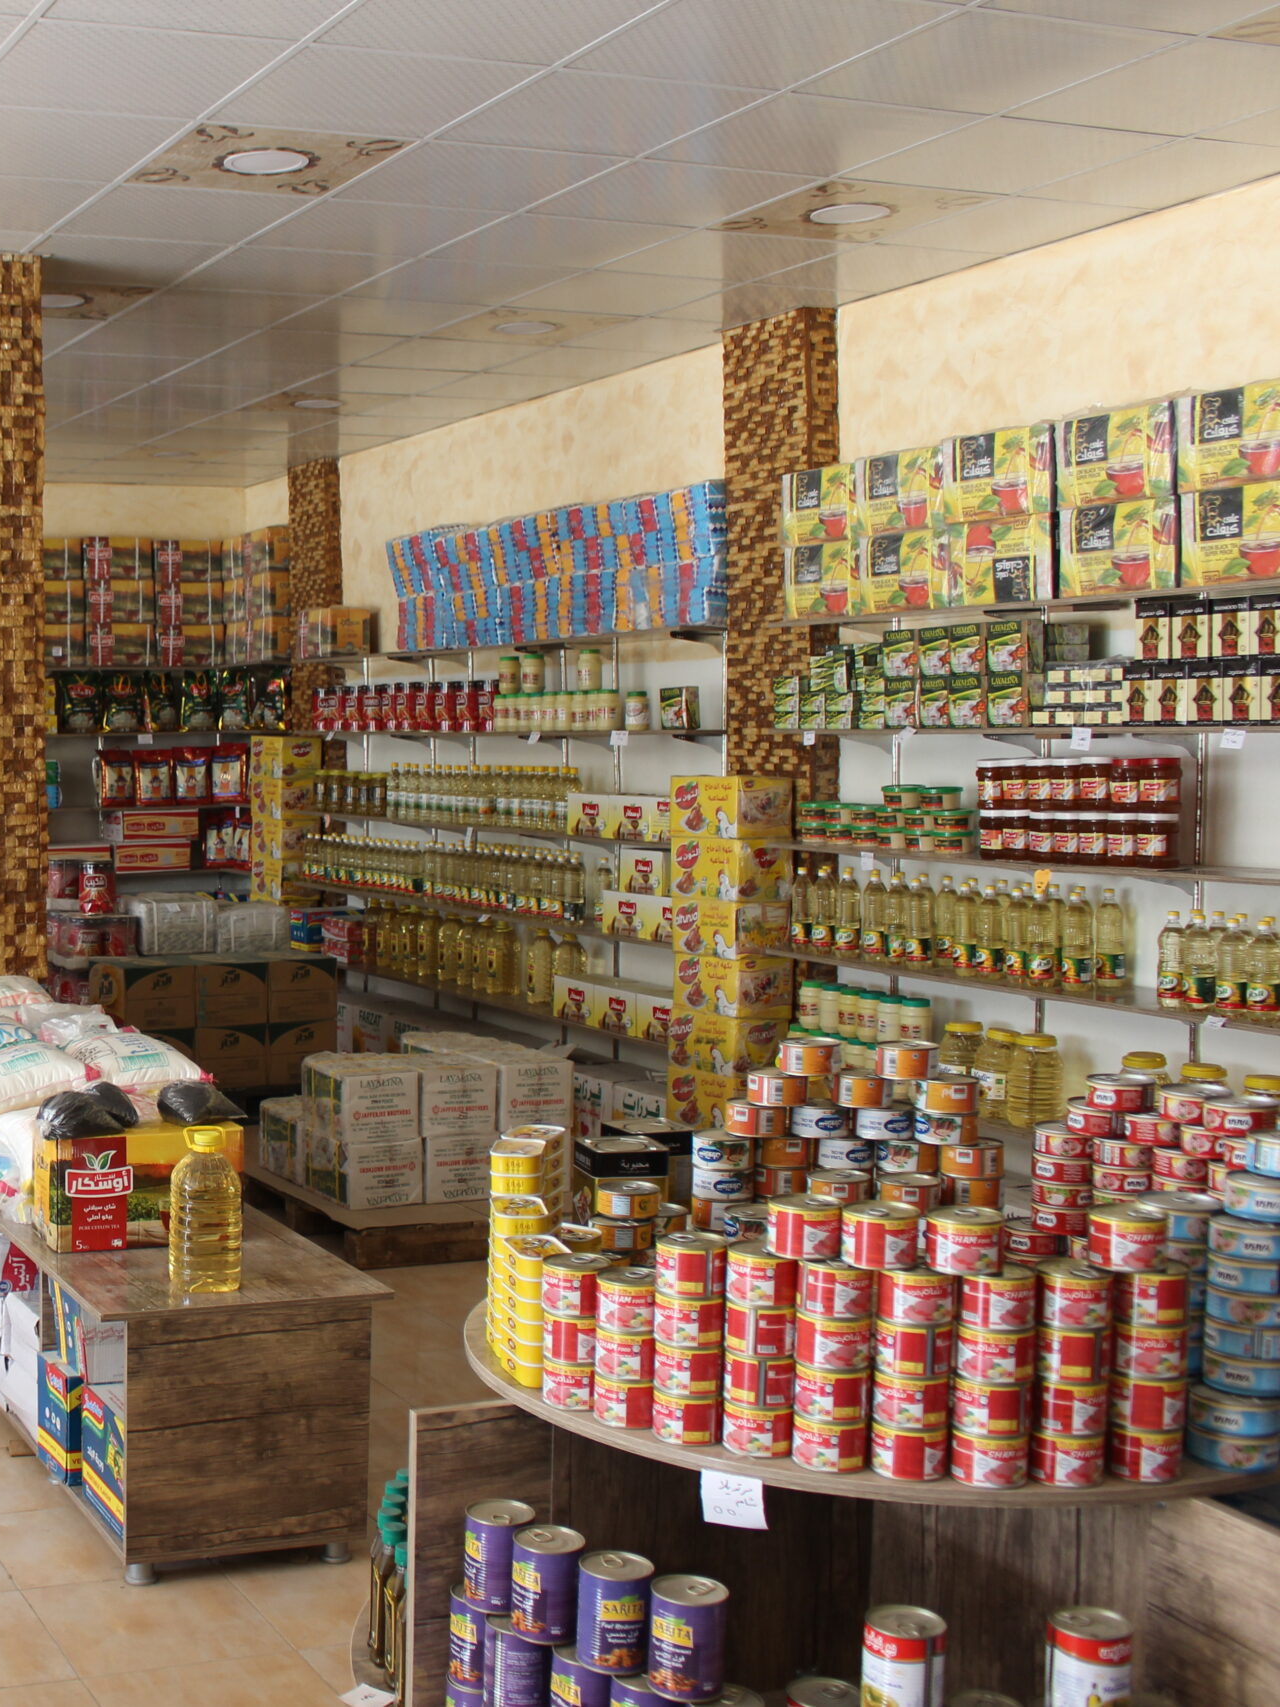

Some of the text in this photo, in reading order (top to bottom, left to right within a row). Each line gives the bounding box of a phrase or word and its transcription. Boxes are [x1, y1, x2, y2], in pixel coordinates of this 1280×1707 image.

[358, 1008, 383, 1026] FARZAT
[465, 1104, 489, 1114] BROTHERS
[623, 1092, 661, 1119] فرزات
[387, 1108, 412, 1118] BROTHERS
[69, 1170, 129, 1194] أوسكار
[83, 1203, 117, 1213] شاي سيلاني
[87, 1213, 113, 1222] بيكو أصلي
[608, 1294, 632, 1304] SHAM
[602, 1601, 644, 1616] SARITA
[652, 1618, 694, 1643] SARITA
